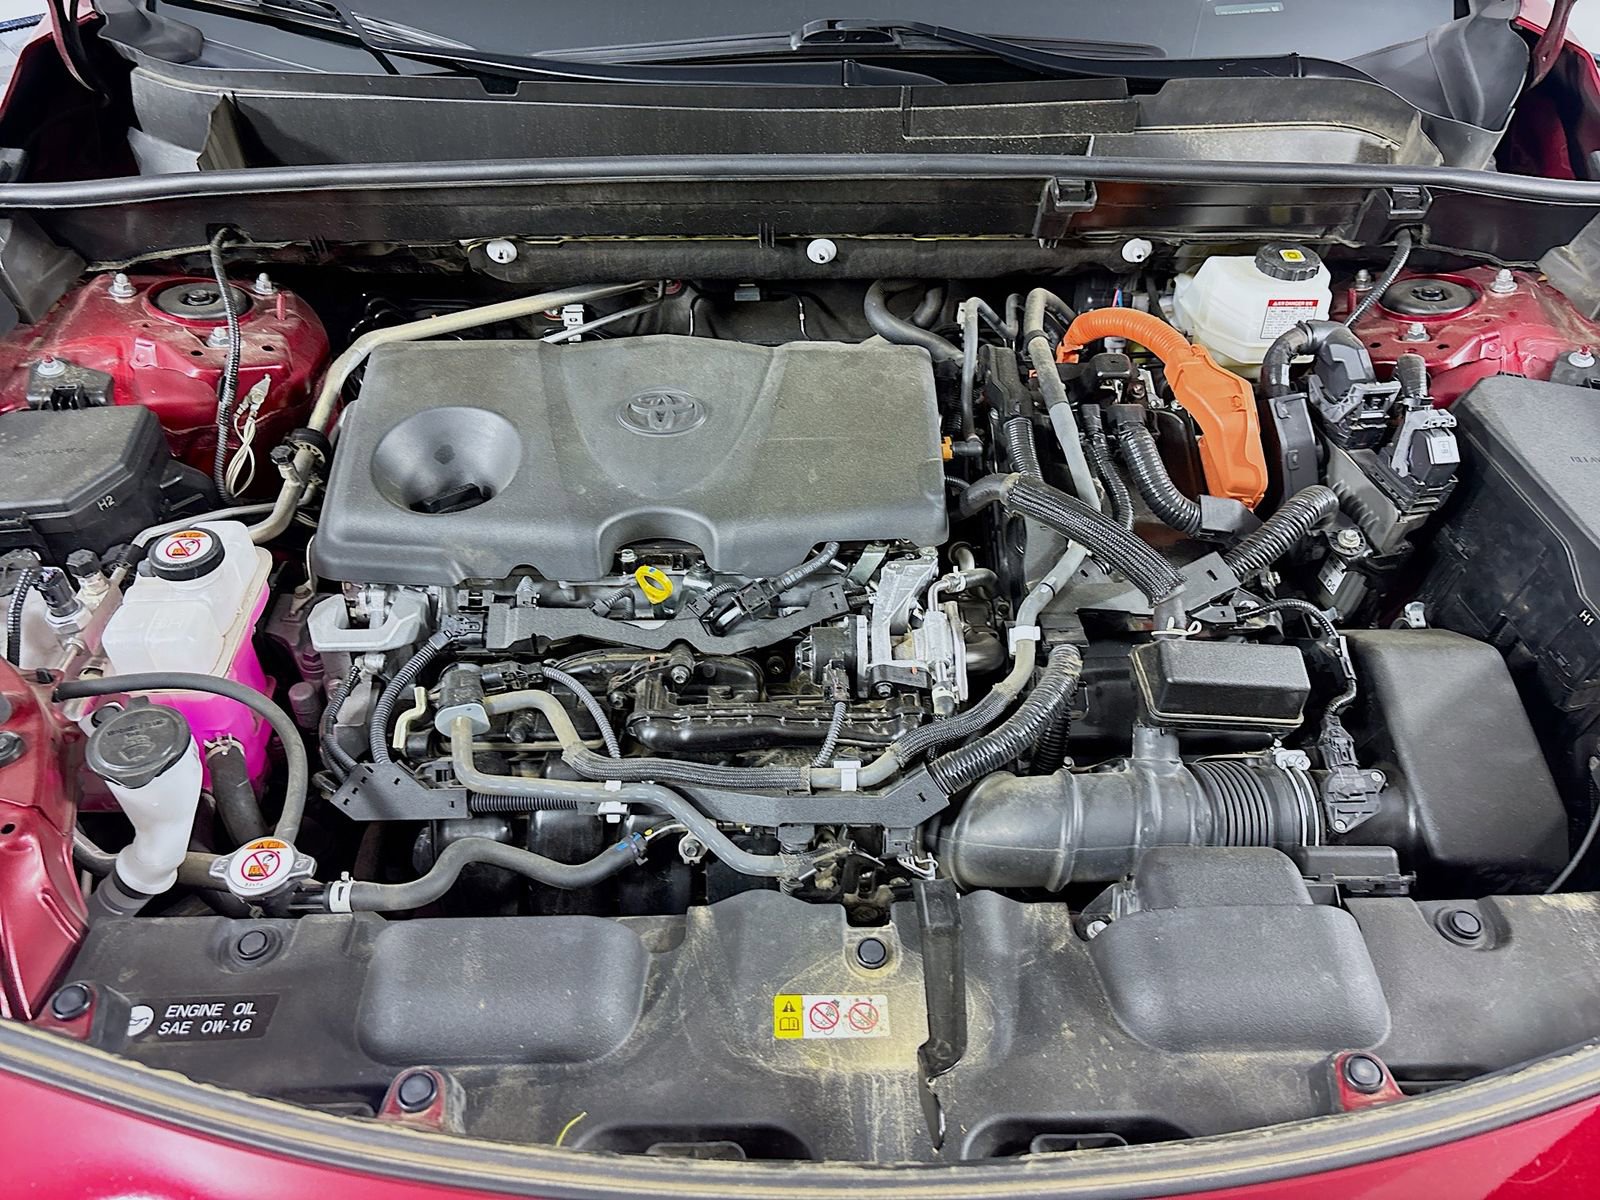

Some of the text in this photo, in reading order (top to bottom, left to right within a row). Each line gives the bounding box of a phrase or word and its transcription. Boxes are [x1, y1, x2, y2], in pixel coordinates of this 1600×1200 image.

[96, 495, 115, 511] H2
[1578, 609, 1595, 626] H1
[165, 1002, 257, 1018] ENGINE OIL
[157, 1019, 253, 1035] SAE 0W-16
